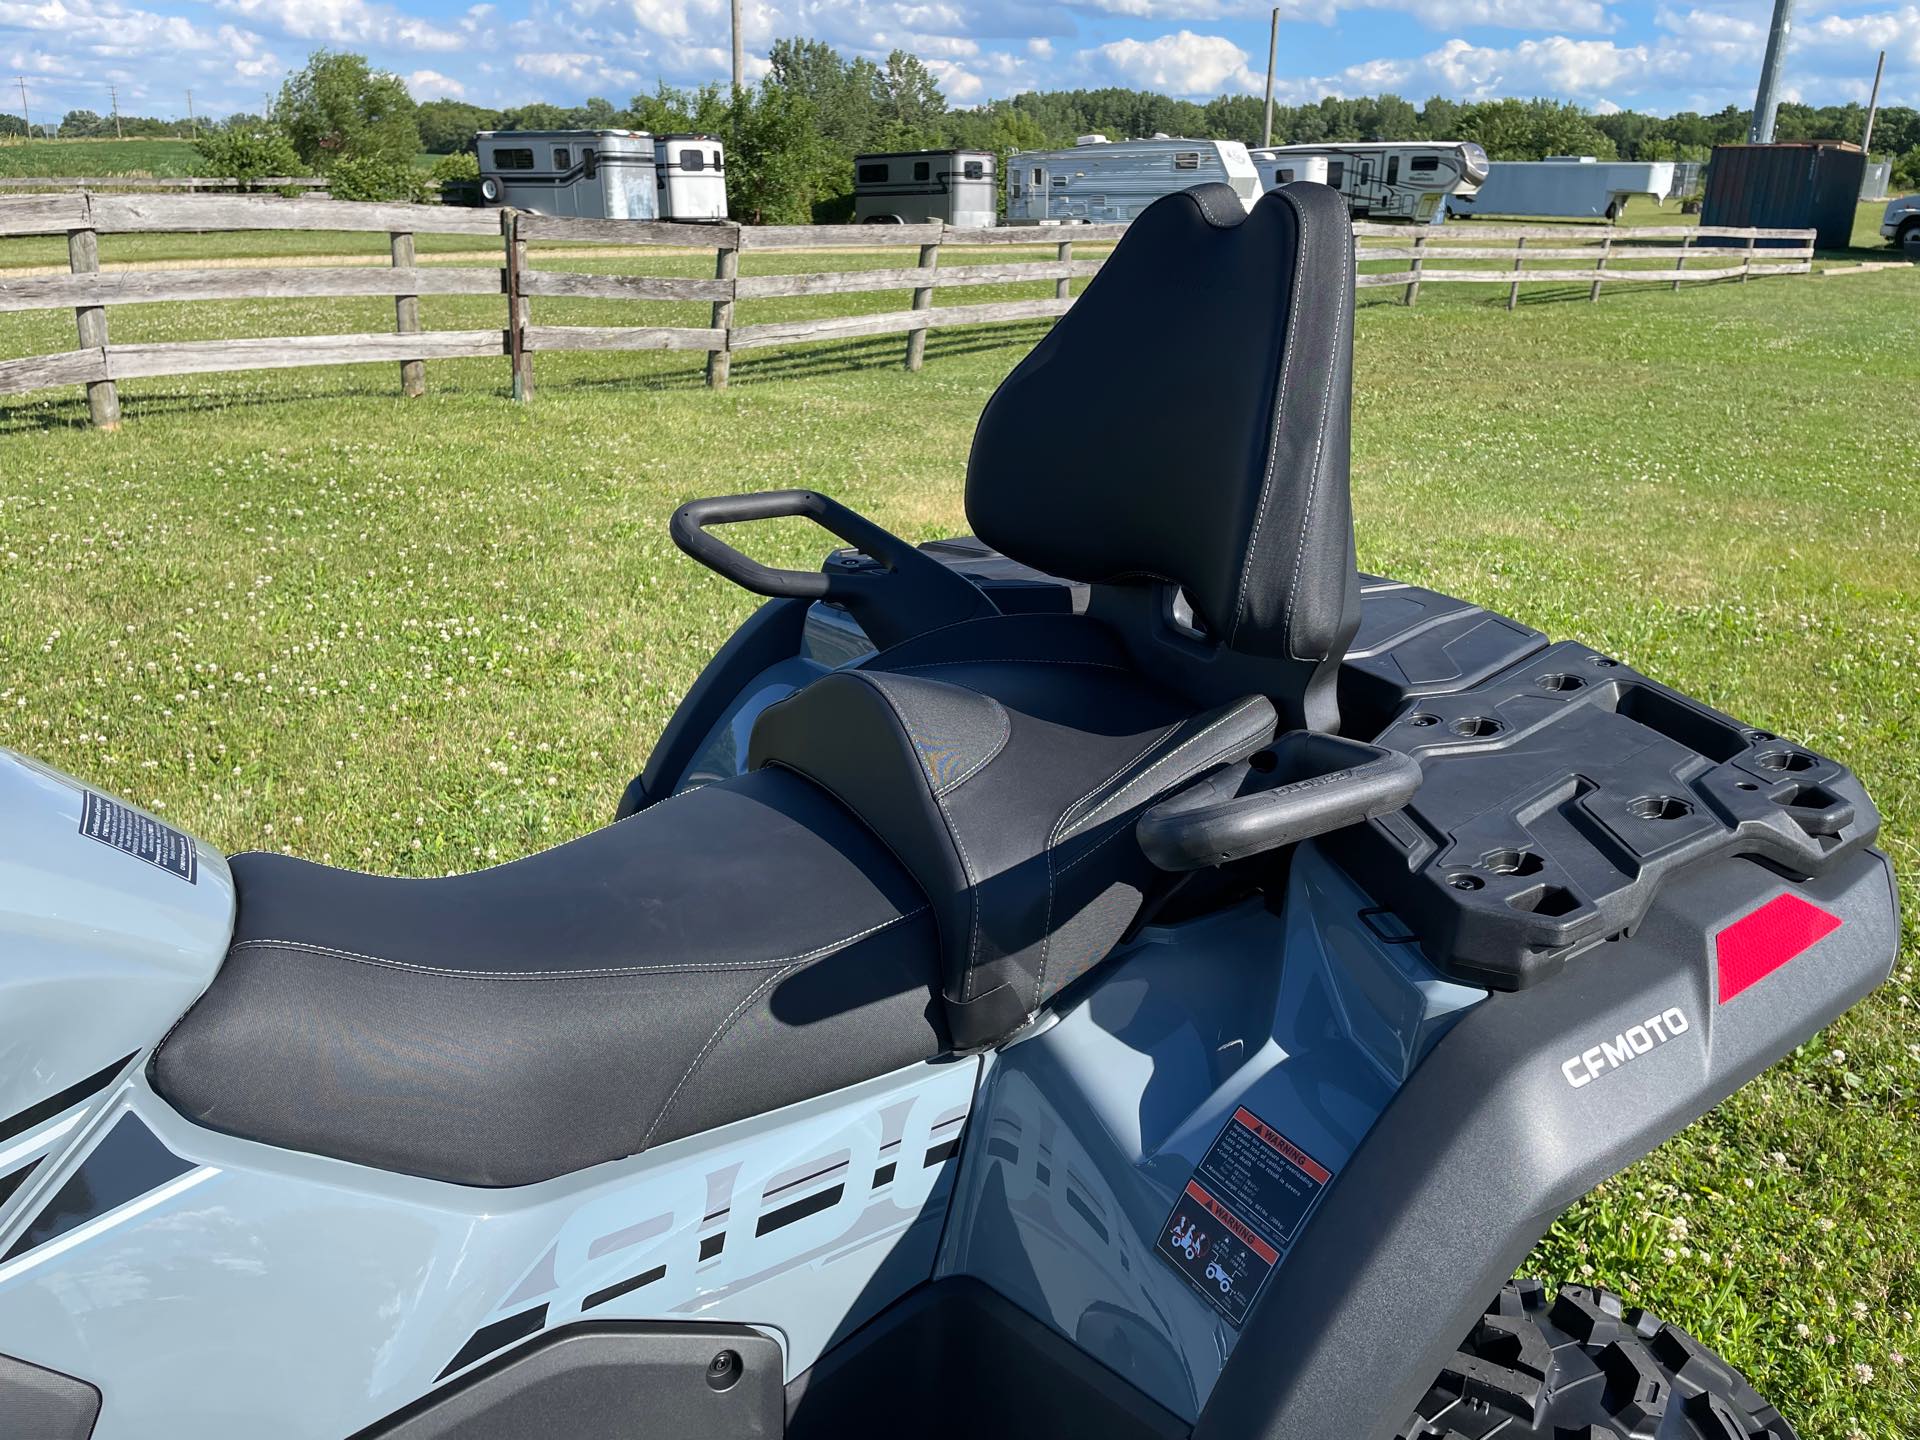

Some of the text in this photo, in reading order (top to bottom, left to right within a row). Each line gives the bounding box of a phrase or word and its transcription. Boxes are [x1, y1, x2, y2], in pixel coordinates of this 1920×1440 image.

[1561, 1007, 1689, 1089] CFMOTO
[1228, 1128, 1238, 1138] can
[1236, 1135, 1250, 1148] cause
[1249, 1145, 1260, 1156] loss
[1259, 1152, 1266, 1160] of
[1262, 1129, 1306, 1166] WARNING
[1240, 1146, 1257, 1162] control
[1256, 1159, 1266, 1169] can
[1283, 1181, 1301, 1197] severe
[1213, 1205, 1256, 1245] WARNING
